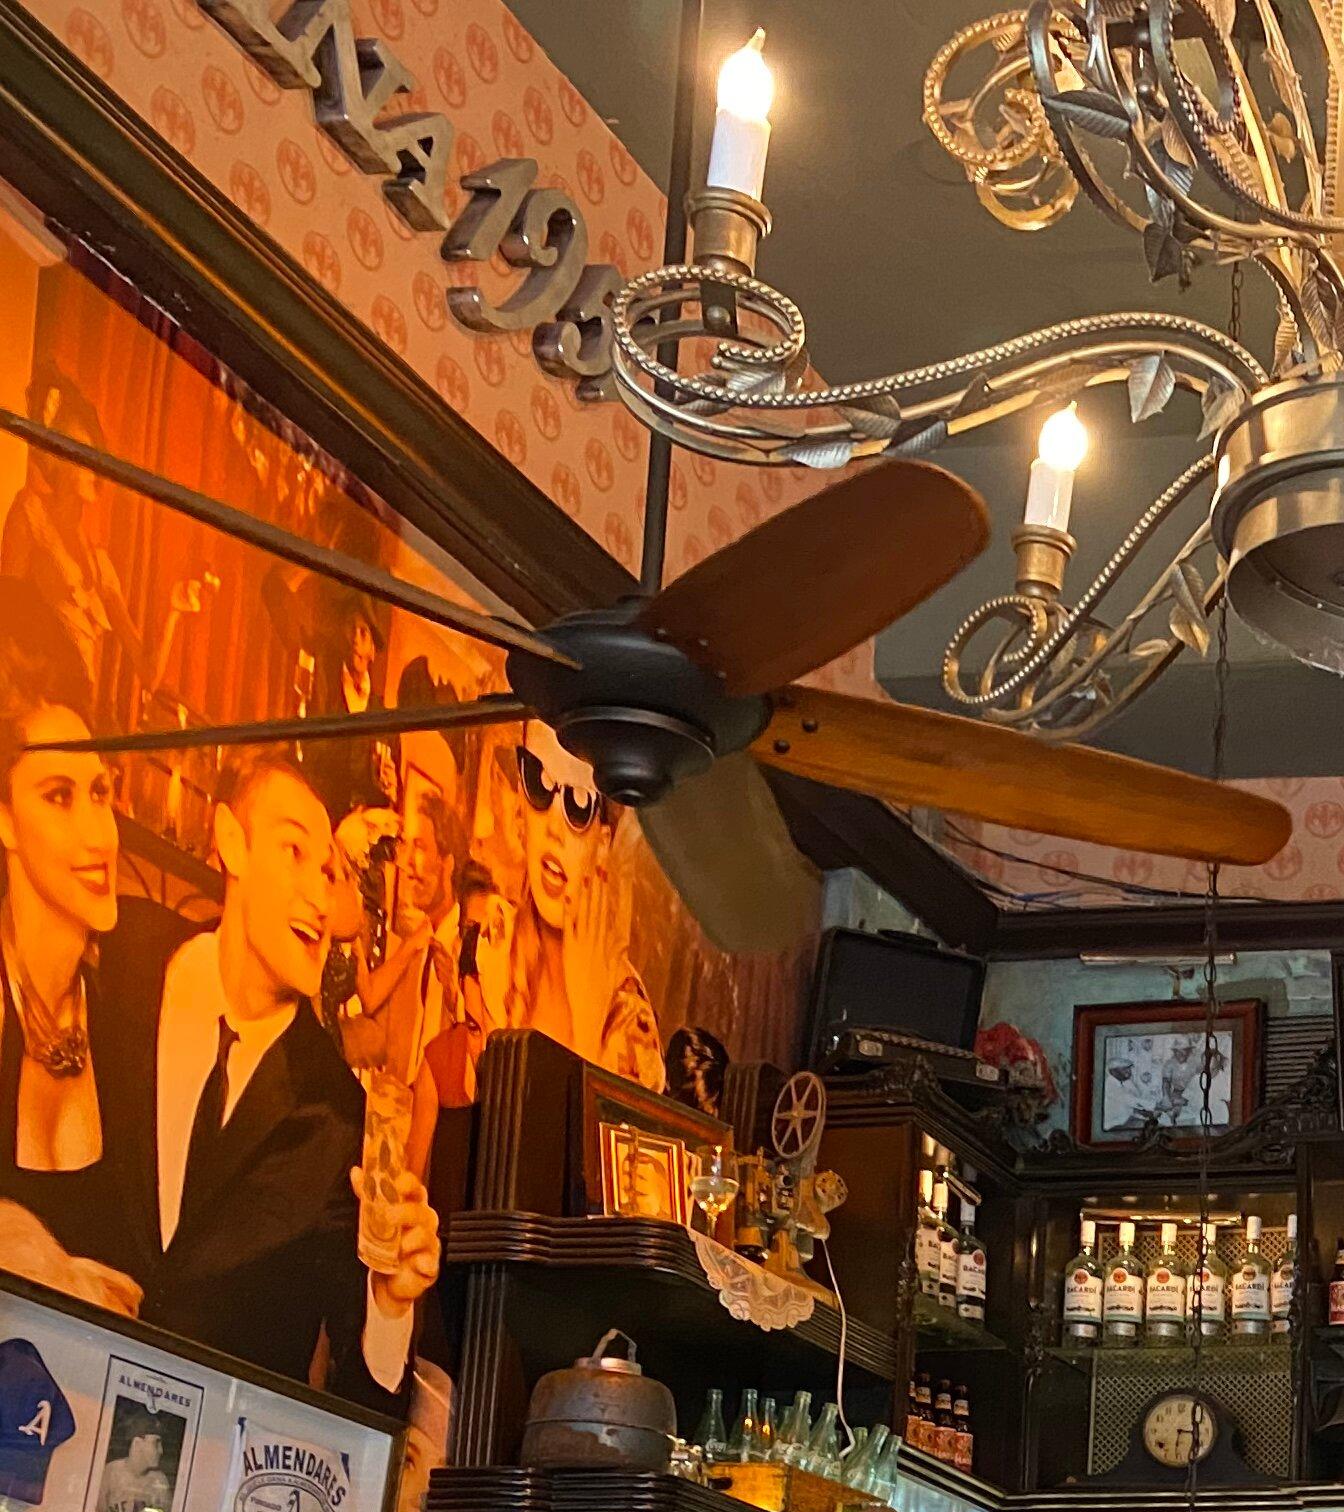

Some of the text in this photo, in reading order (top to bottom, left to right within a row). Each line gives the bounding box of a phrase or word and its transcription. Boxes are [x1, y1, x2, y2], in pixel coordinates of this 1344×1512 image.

[196, 0, 658, 403] NA 195
[243, 1445, 346, 1506] ALMENDARES
